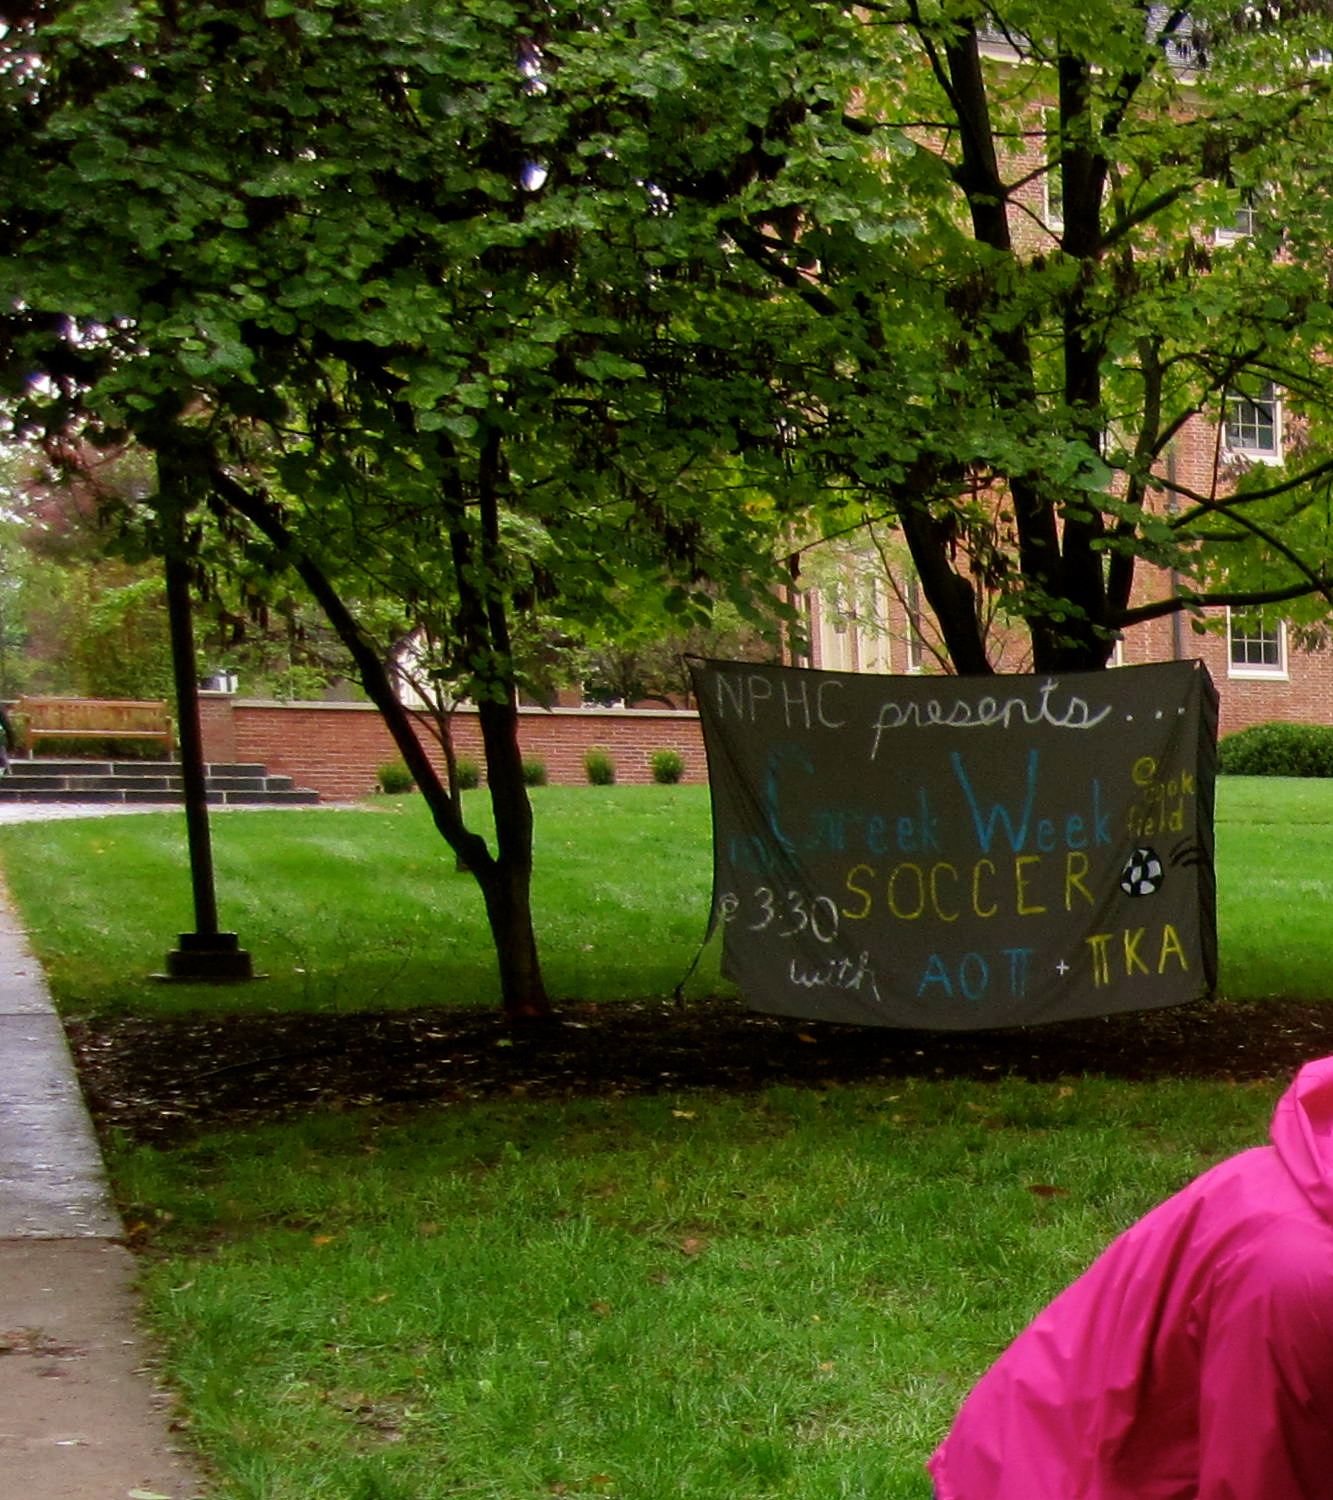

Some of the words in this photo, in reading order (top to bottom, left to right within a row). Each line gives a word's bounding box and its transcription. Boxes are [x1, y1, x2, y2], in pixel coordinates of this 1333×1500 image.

[717, 674, 846, 729] NPHC
[951, 748, 1113, 854] Week
[750, 886, 839, 944] 3:30
[842, 852, 1095, 920] SOCCER
[788, 949, 881, 1001] with
